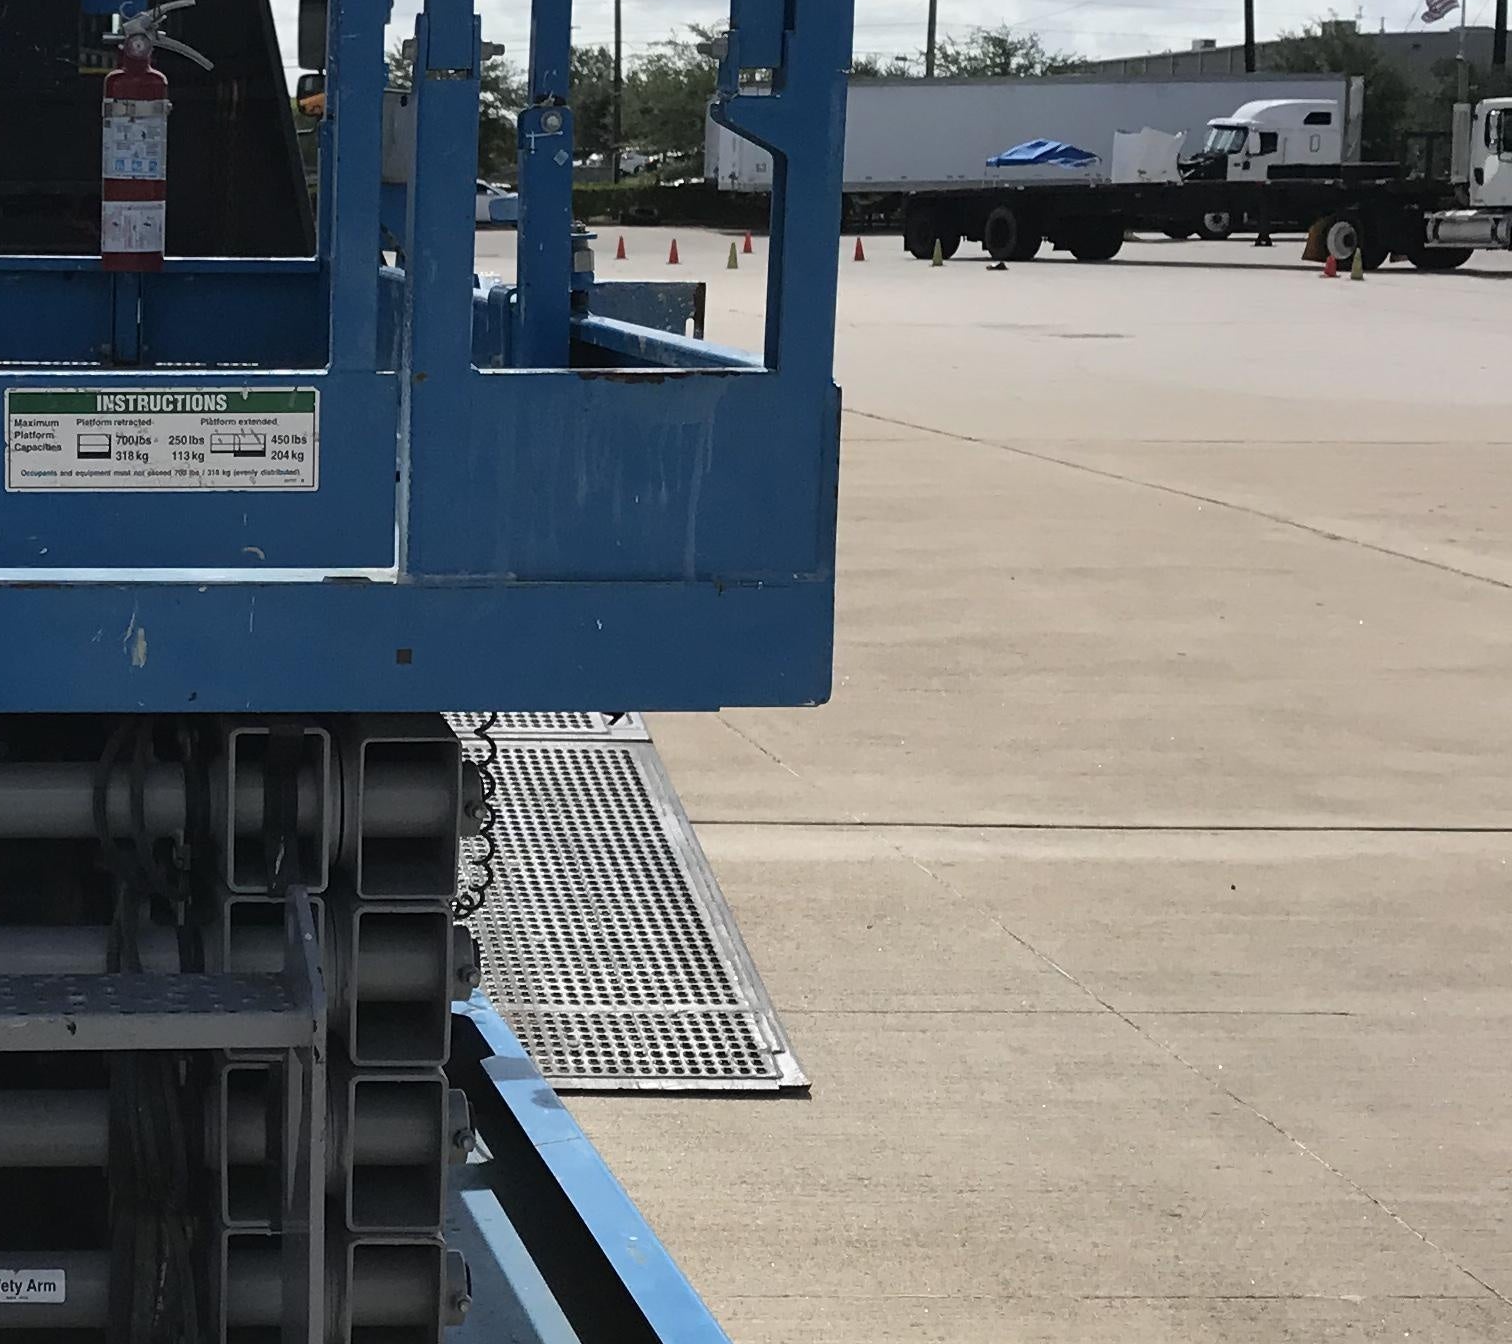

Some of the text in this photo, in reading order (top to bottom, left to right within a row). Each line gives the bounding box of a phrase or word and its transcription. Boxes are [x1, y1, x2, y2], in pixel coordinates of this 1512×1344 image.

[96, 393, 228, 412] INSTRUCTIONS
[14, 419, 60, 427] Maximum
[76, 418, 152, 426] Platform retracted
[200, 418, 277, 426] Platform extended
[14, 431, 55, 439] Platform
[116, 435, 152, 445] 700 lbs
[168, 435, 205, 445] 250 lbs
[271, 434, 307, 444] 450 lbs
[14, 443, 62, 452] Capacities
[116, 451, 149, 463] 318 kg
[172, 451, 205, 463] 113 kg
[271, 450, 304, 462] 204 kg
[20, 469, 57, 478] Occupants
[75, 469, 111, 478] equipment
[26, 1278, 57, 1292] Arm
